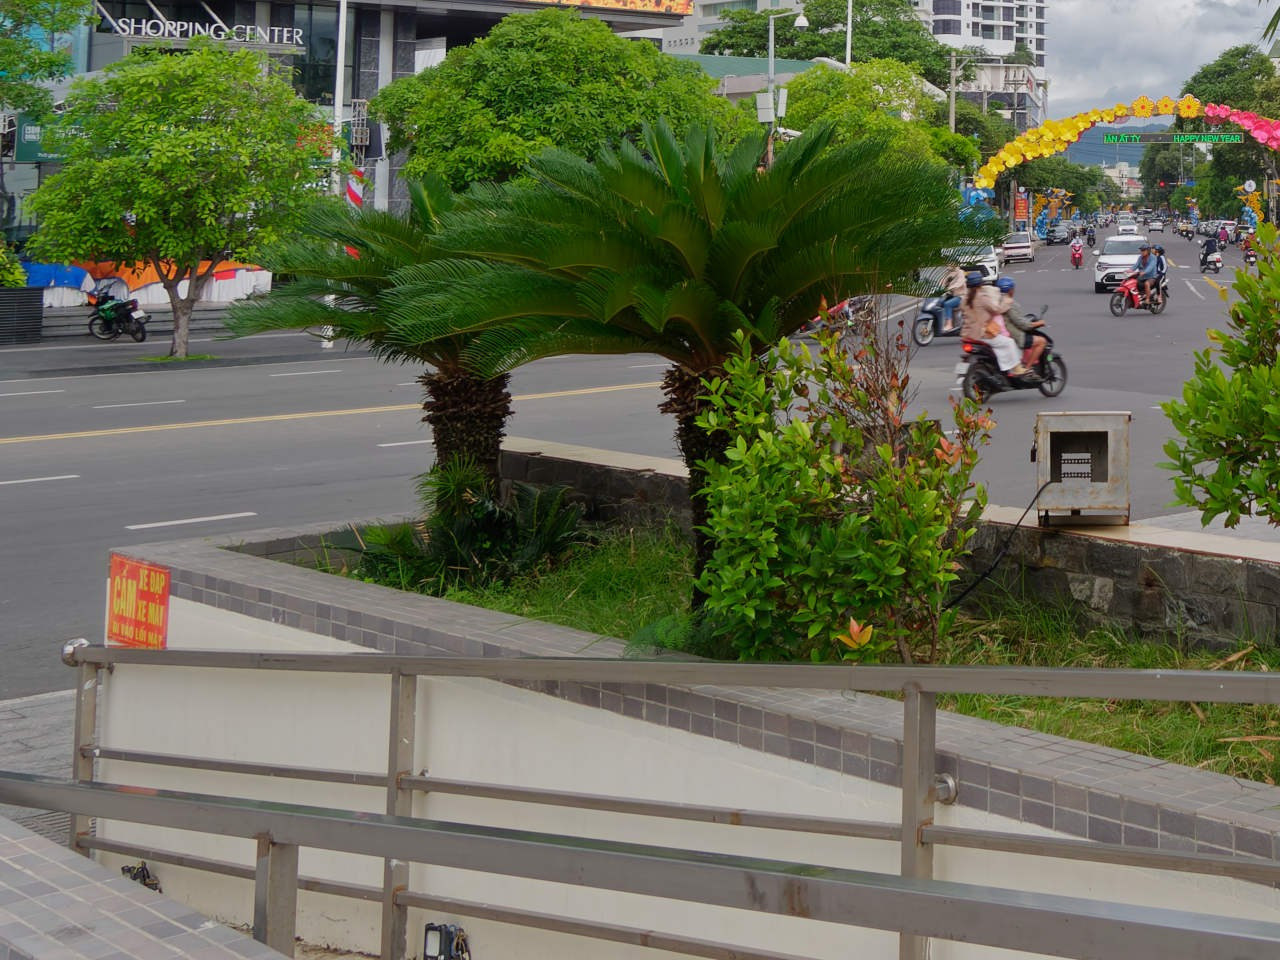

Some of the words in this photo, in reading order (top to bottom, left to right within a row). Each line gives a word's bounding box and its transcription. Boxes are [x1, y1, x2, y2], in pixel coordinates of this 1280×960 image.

[117, 17, 225, 40] SHOPPING
[232, 24, 304, 45] CENTER
[1173, 134, 1200, 143] HAPPY
[1201, 134, 1219, 143] NEW
[1220, 134, 1241, 143] YEAR
